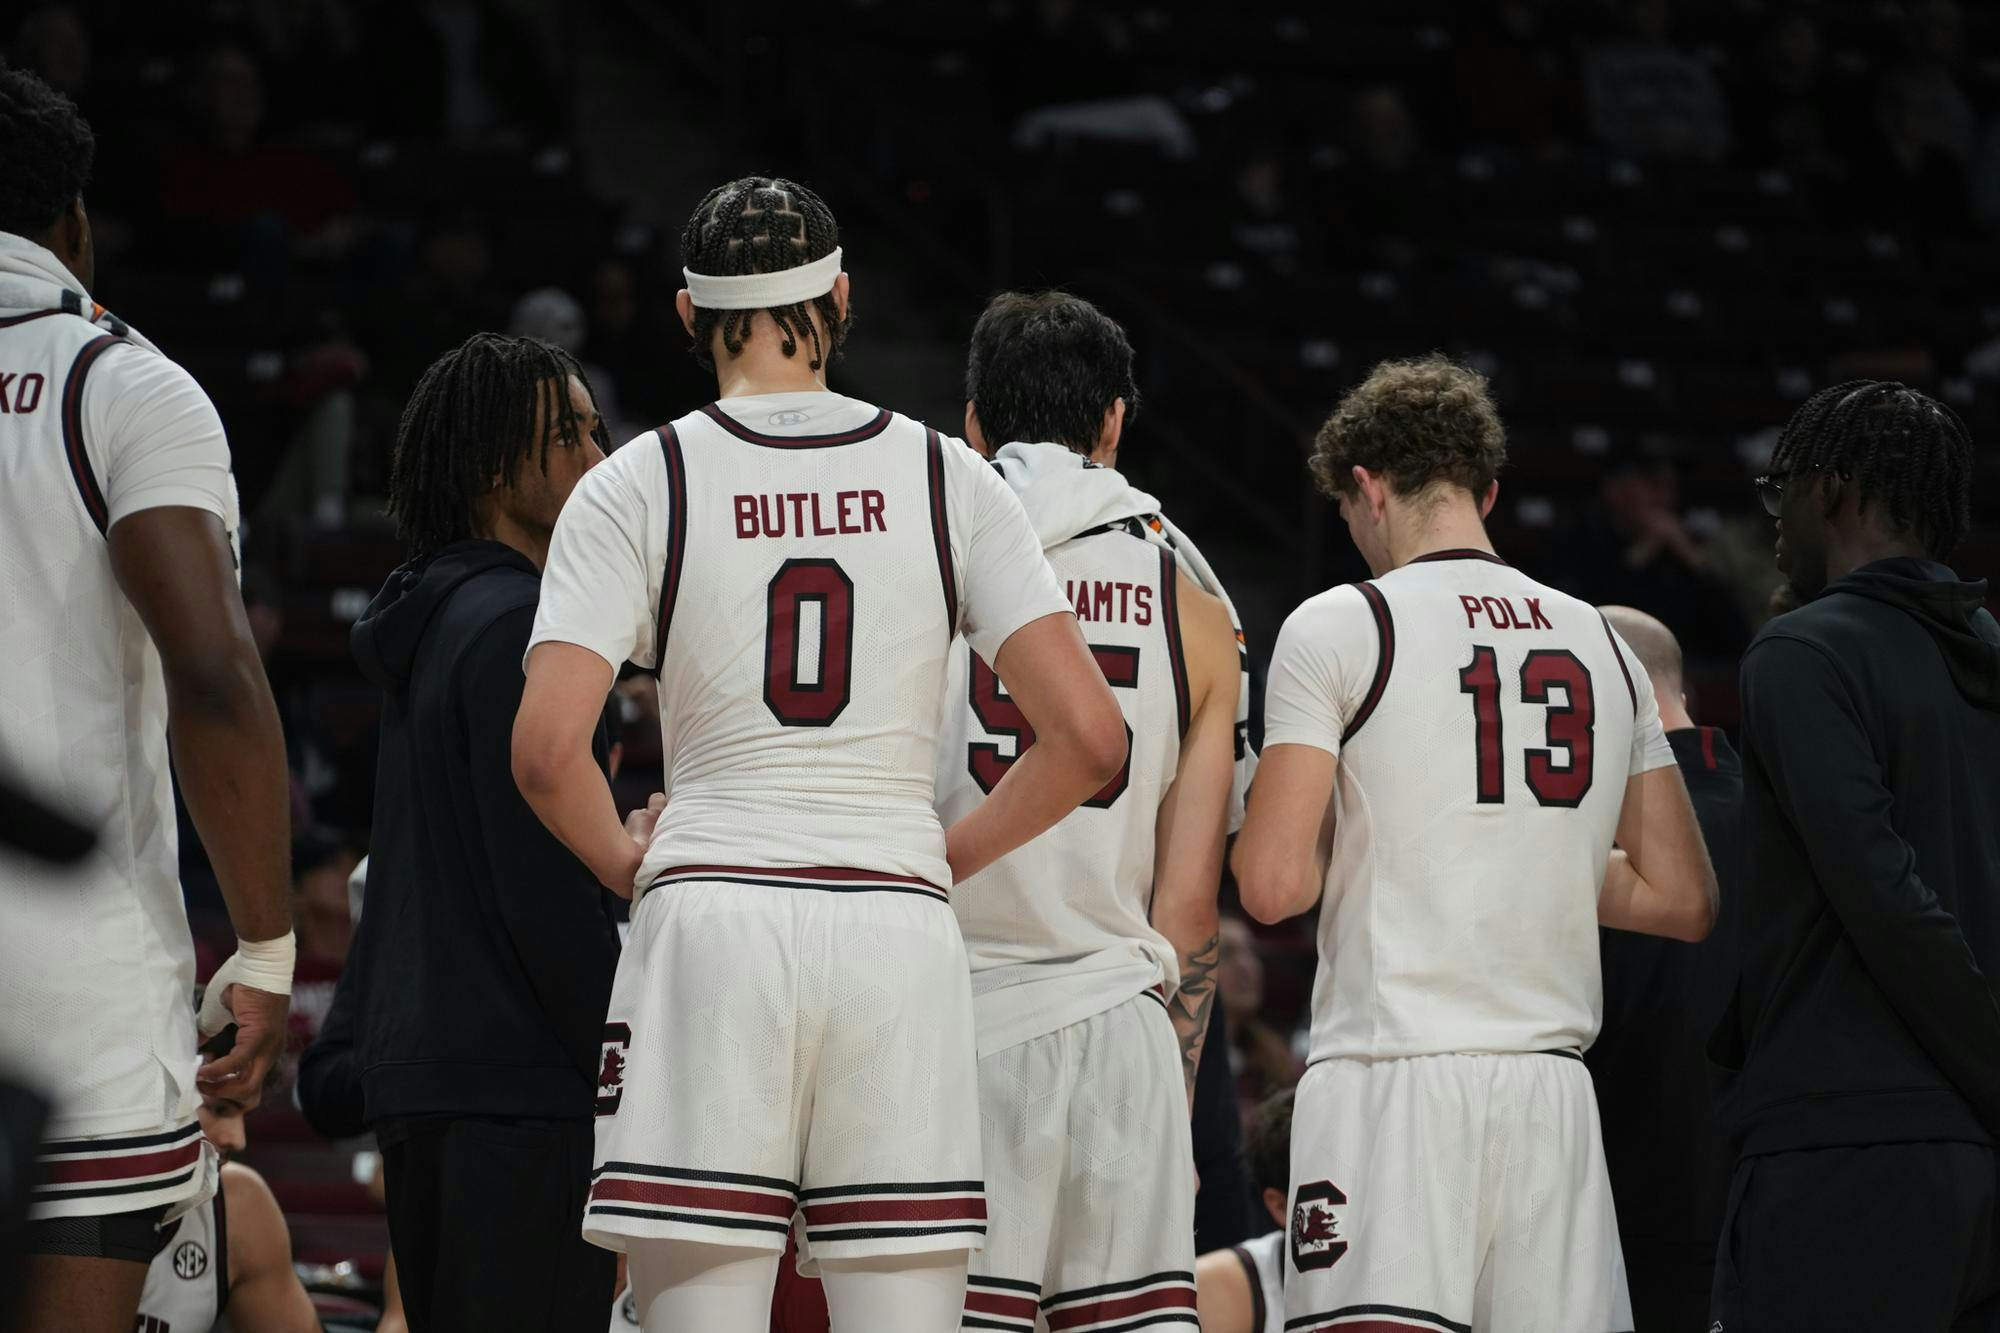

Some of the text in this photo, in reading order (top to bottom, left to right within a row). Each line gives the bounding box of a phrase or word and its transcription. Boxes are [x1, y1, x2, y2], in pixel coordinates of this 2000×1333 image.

[0, 372, 45, 414] KO
[733, 489, 888, 539] BUTLER
[1458, 594, 1553, 630] POLK
[762, 557, 855, 728] 0
[1458, 644, 1596, 809] 13
[174, 1241, 208, 1280] SEC
